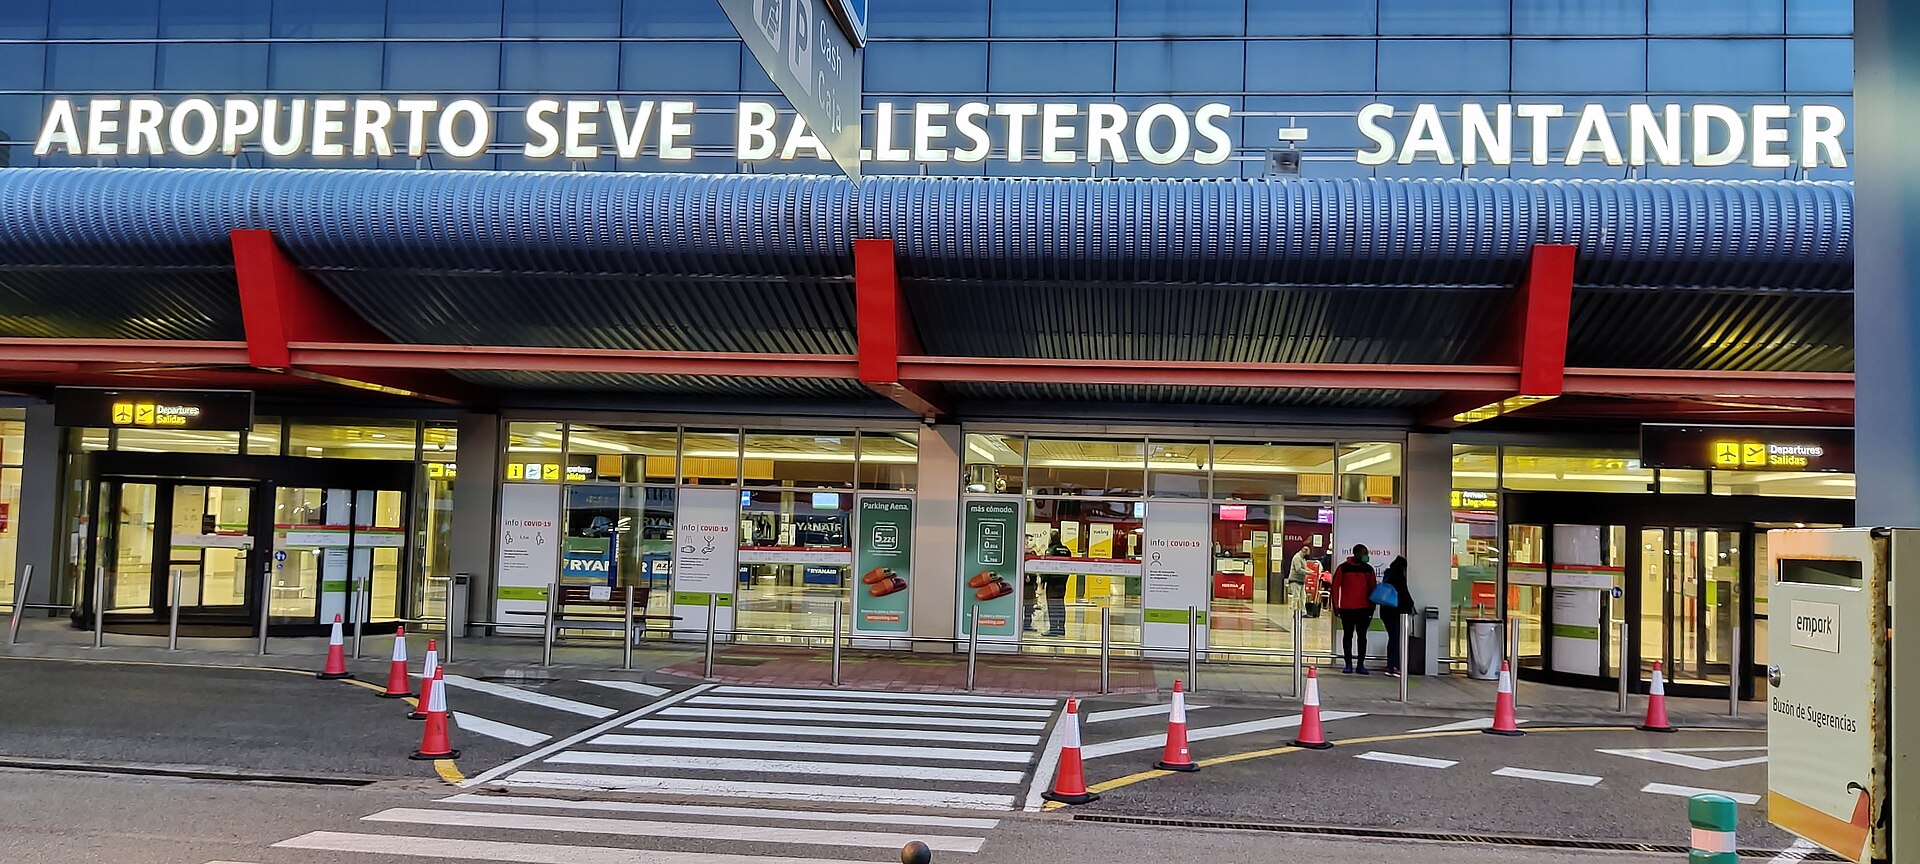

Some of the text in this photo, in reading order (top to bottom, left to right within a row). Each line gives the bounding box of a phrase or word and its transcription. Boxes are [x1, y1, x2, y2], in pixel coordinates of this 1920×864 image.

[819, 19, 842, 81] Cash
[817, 70, 842, 134] Caja
[34, 98, 490, 157] AEROPUERTO
[524, 99, 694, 160] SEVE
[738, 102, 1232, 165] BALESTEROS
[1356, 103, 1847, 169] SANTANDER
[157, 405, 200, 416] Departures
[156, 415, 187, 425] Salidas
[1770, 444, 1823, 457] Departures
[1770, 455, 1808, 466] Salidas
[863, 502, 889, 511] Parking
[796, 522, 842, 532] YANAIR
[1093, 528, 1109, 536] vueling
[1150, 539, 1165, 547] info
[1796, 615, 1832, 638] empark
[1772, 696, 1857, 733] Buzón de Sugerencias
